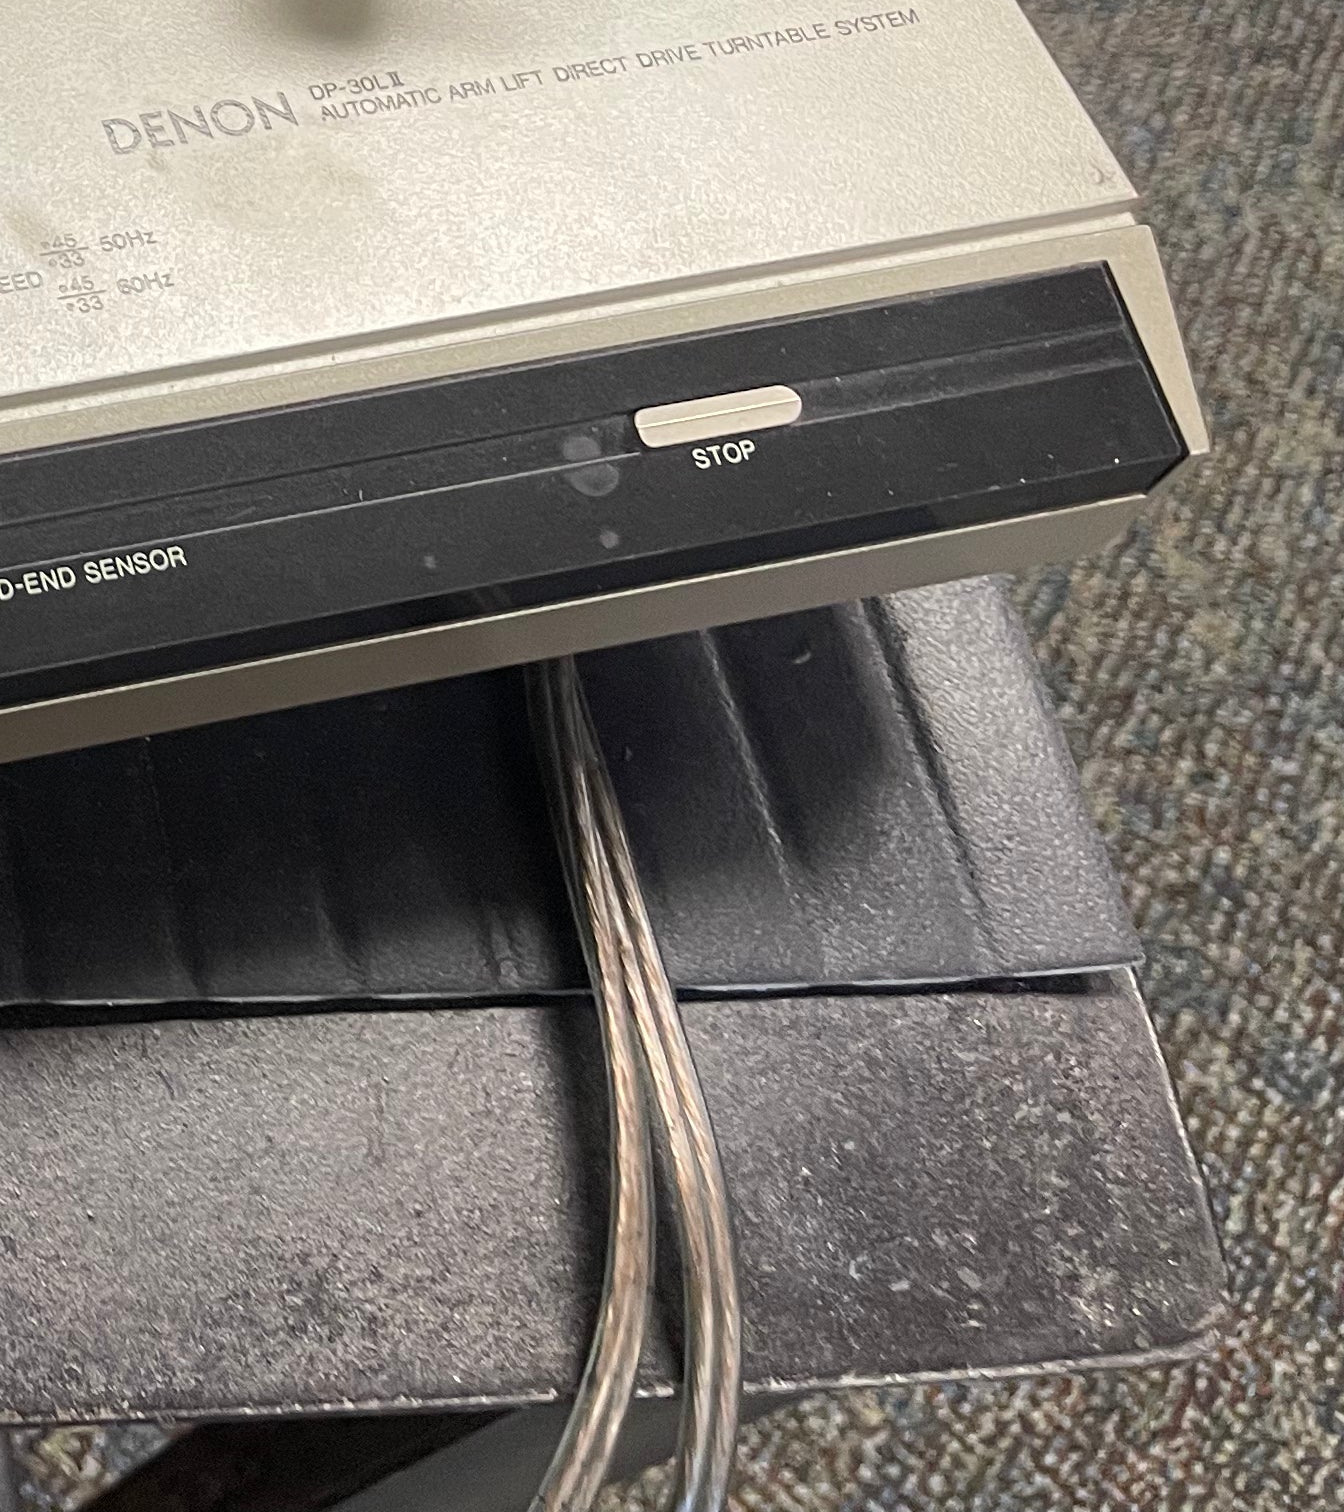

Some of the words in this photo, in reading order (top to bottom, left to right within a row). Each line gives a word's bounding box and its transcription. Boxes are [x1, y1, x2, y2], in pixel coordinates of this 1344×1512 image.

[320, 87, 442, 122] AUTOMATIC
[449, 77, 497, 103] ARM
[499, 69, 544, 93] LIFT
[552, 55, 628, 83] DIRECT
[636, 44, 702, 69] DRIVE
[702, 22, 831, 58] TURNTABLE
[834, 7, 921, 36] SYSTEM
[100, 90, 300, 156] DENON
[99, 229, 159, 253] 50Hz
[116, 271, 176, 295] 60Hz
[691, 438, 756, 470] STOP
[84, 545, 188, 585] SENSOR
